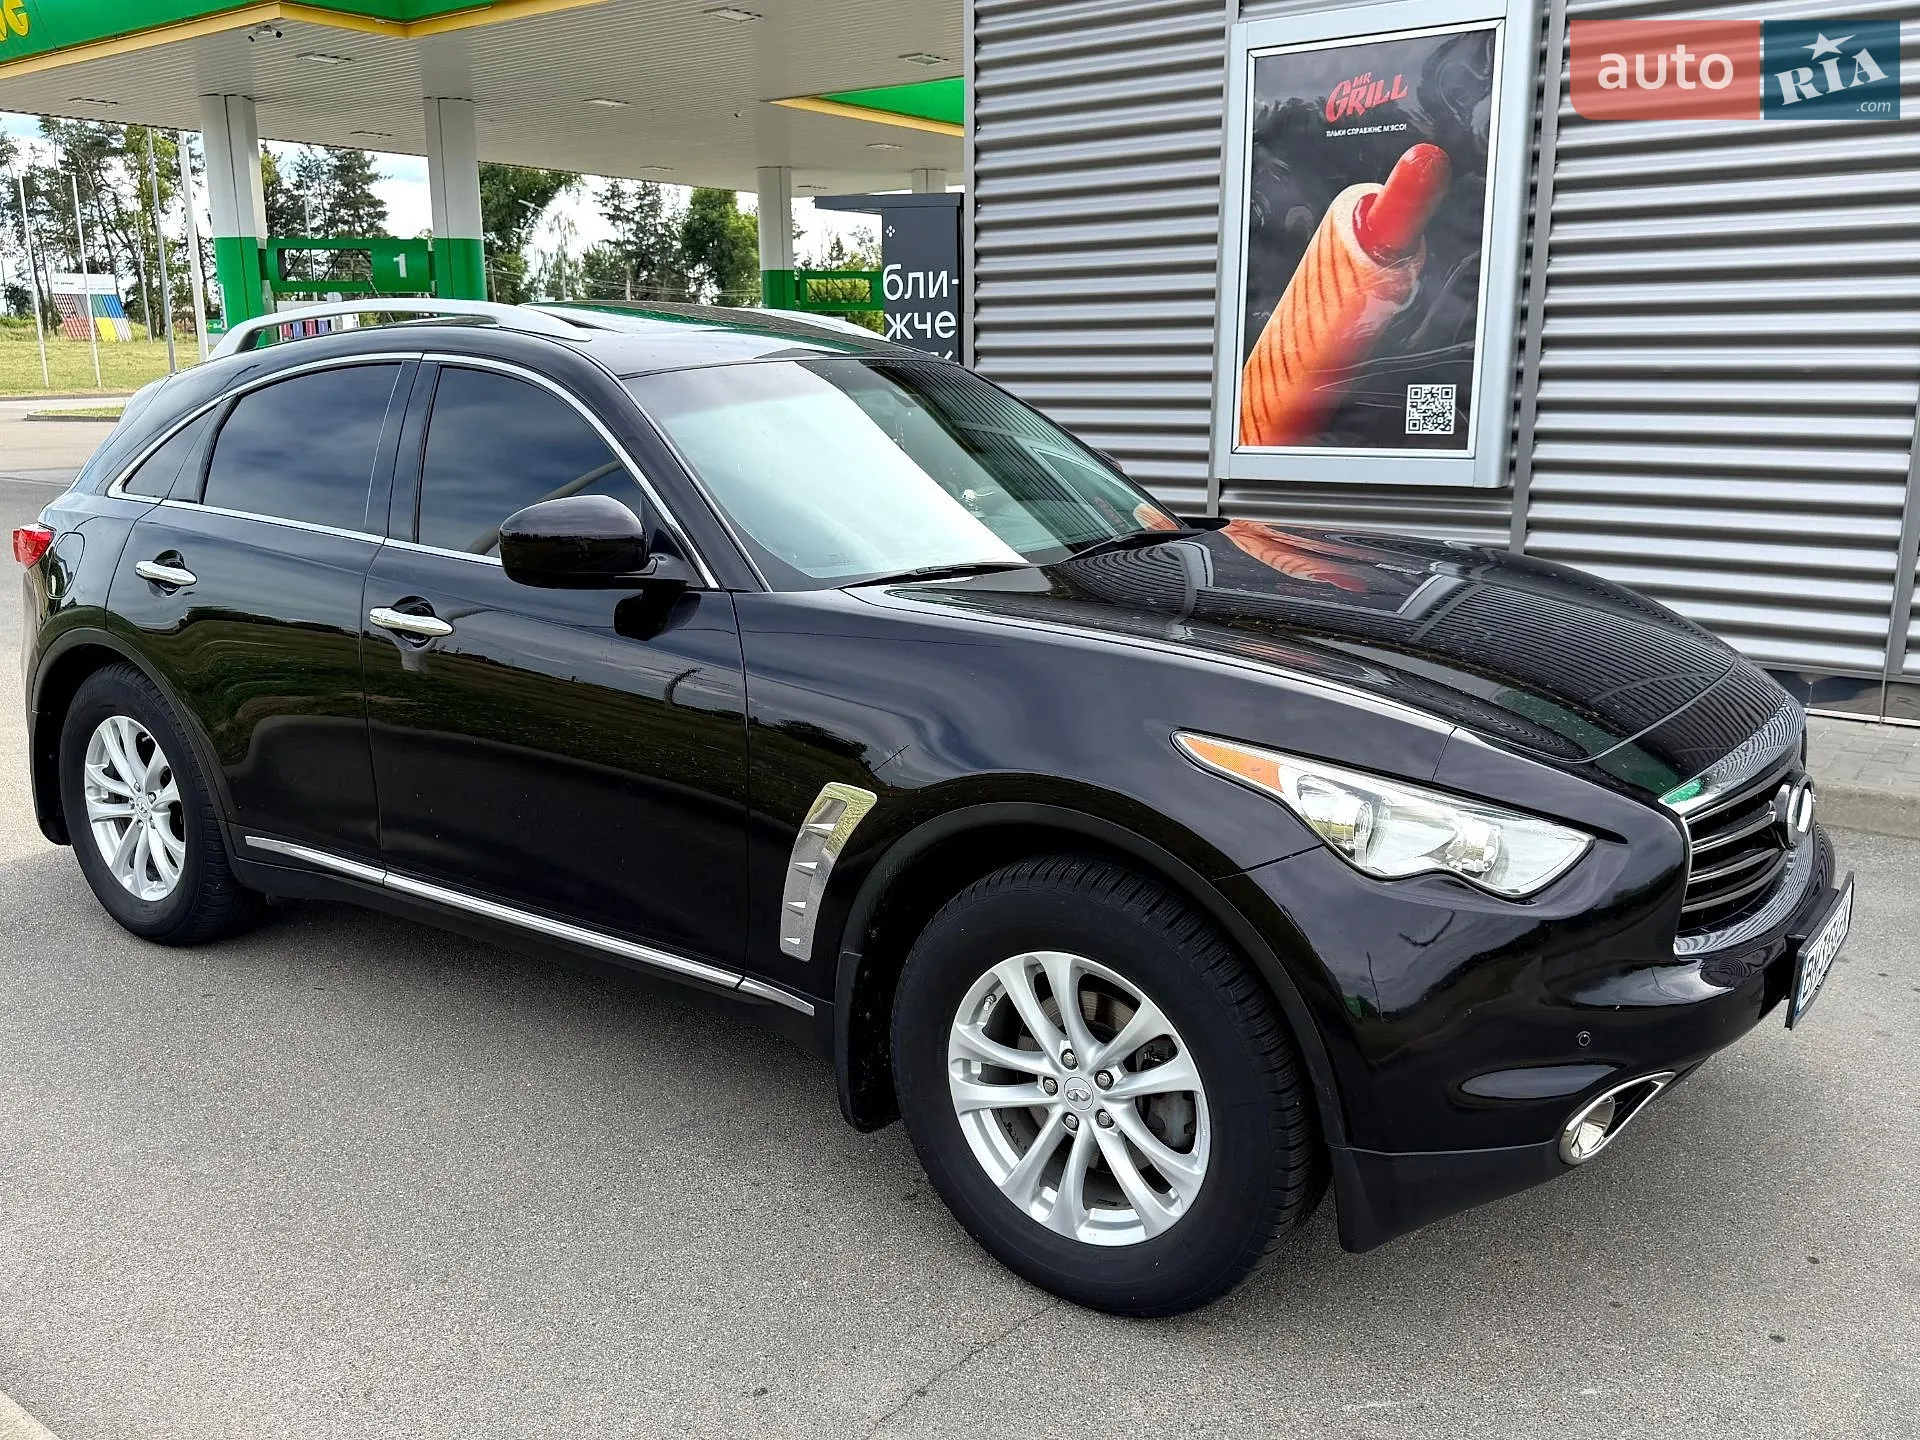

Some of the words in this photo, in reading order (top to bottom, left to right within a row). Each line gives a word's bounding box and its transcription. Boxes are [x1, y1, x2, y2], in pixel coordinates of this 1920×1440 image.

[1325, 73, 1408, 124] GRILL
[393, 253, 408, 279] 1
[882, 264, 959, 301] бли-
[884, 310, 957, 342] жче
